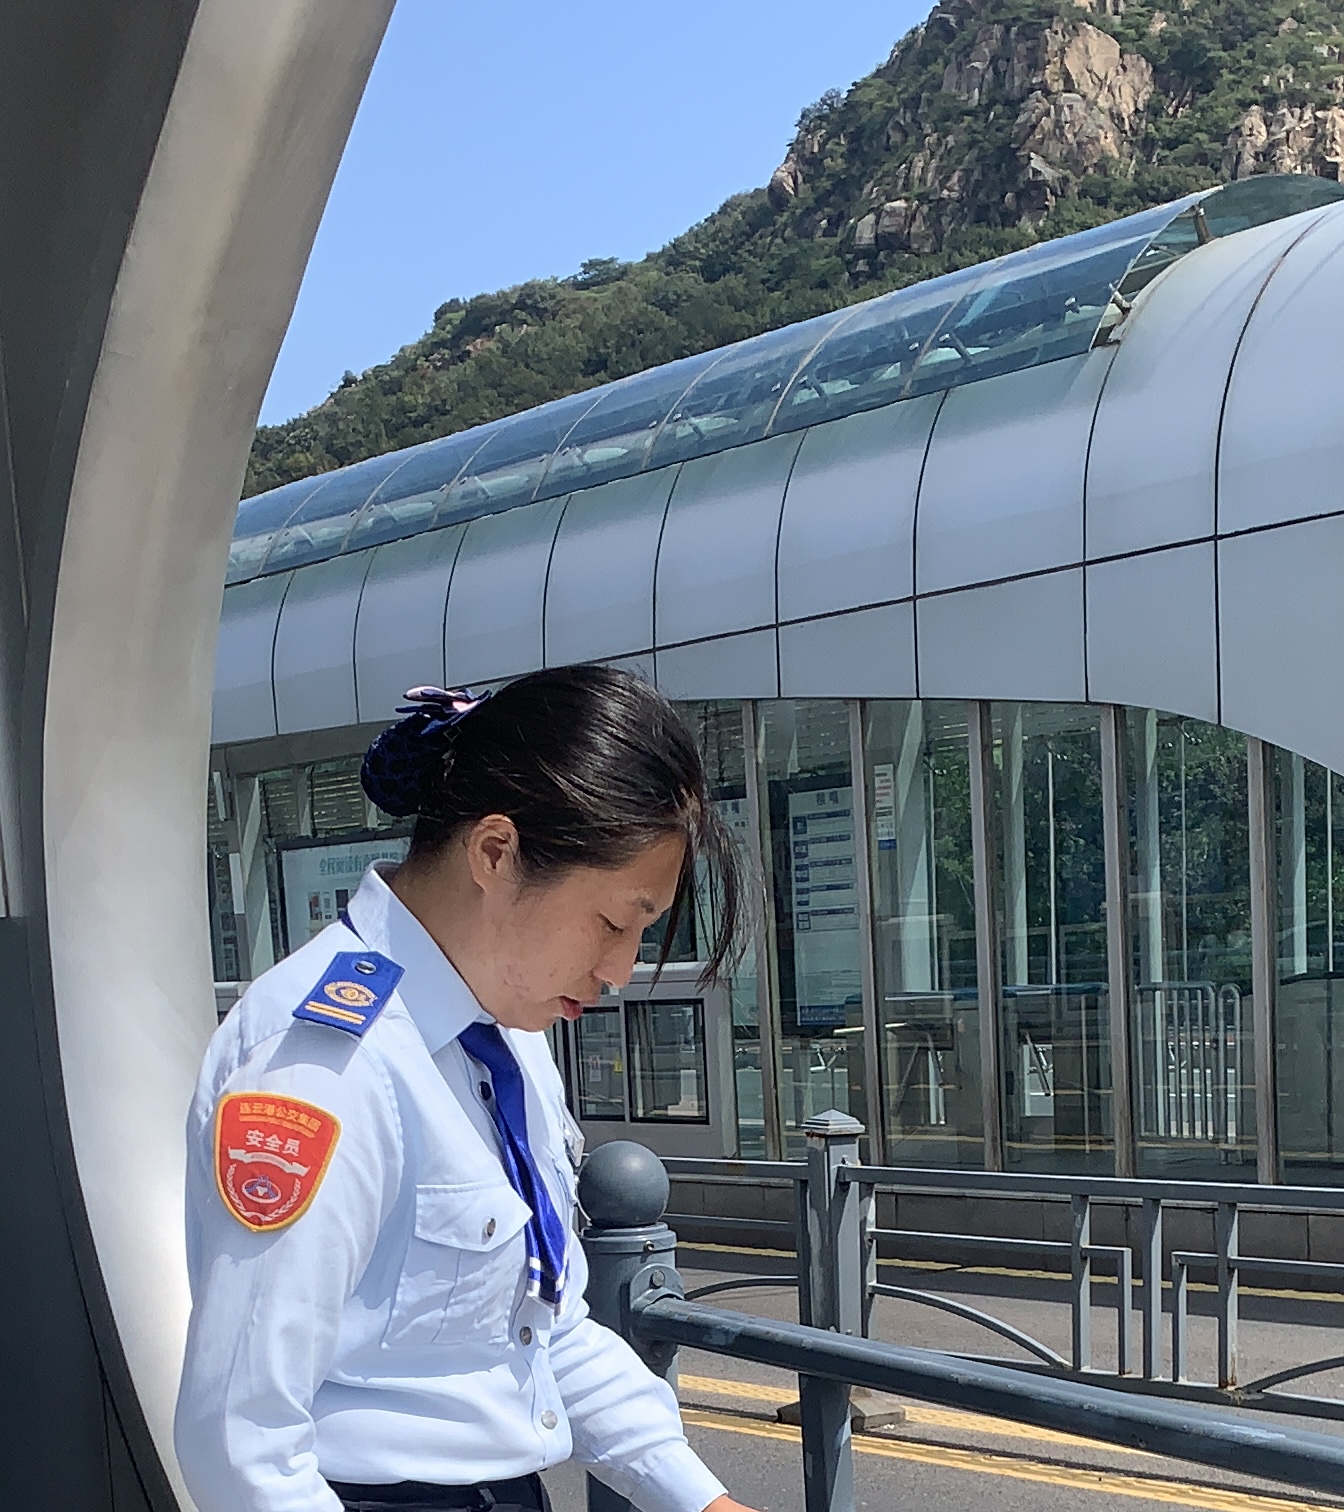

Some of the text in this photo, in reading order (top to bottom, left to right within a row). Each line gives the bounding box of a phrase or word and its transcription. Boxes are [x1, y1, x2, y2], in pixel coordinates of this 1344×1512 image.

[239, 1102, 322, 1132] 连云港公交集团
[245, 1129, 301, 1157] 安全员
